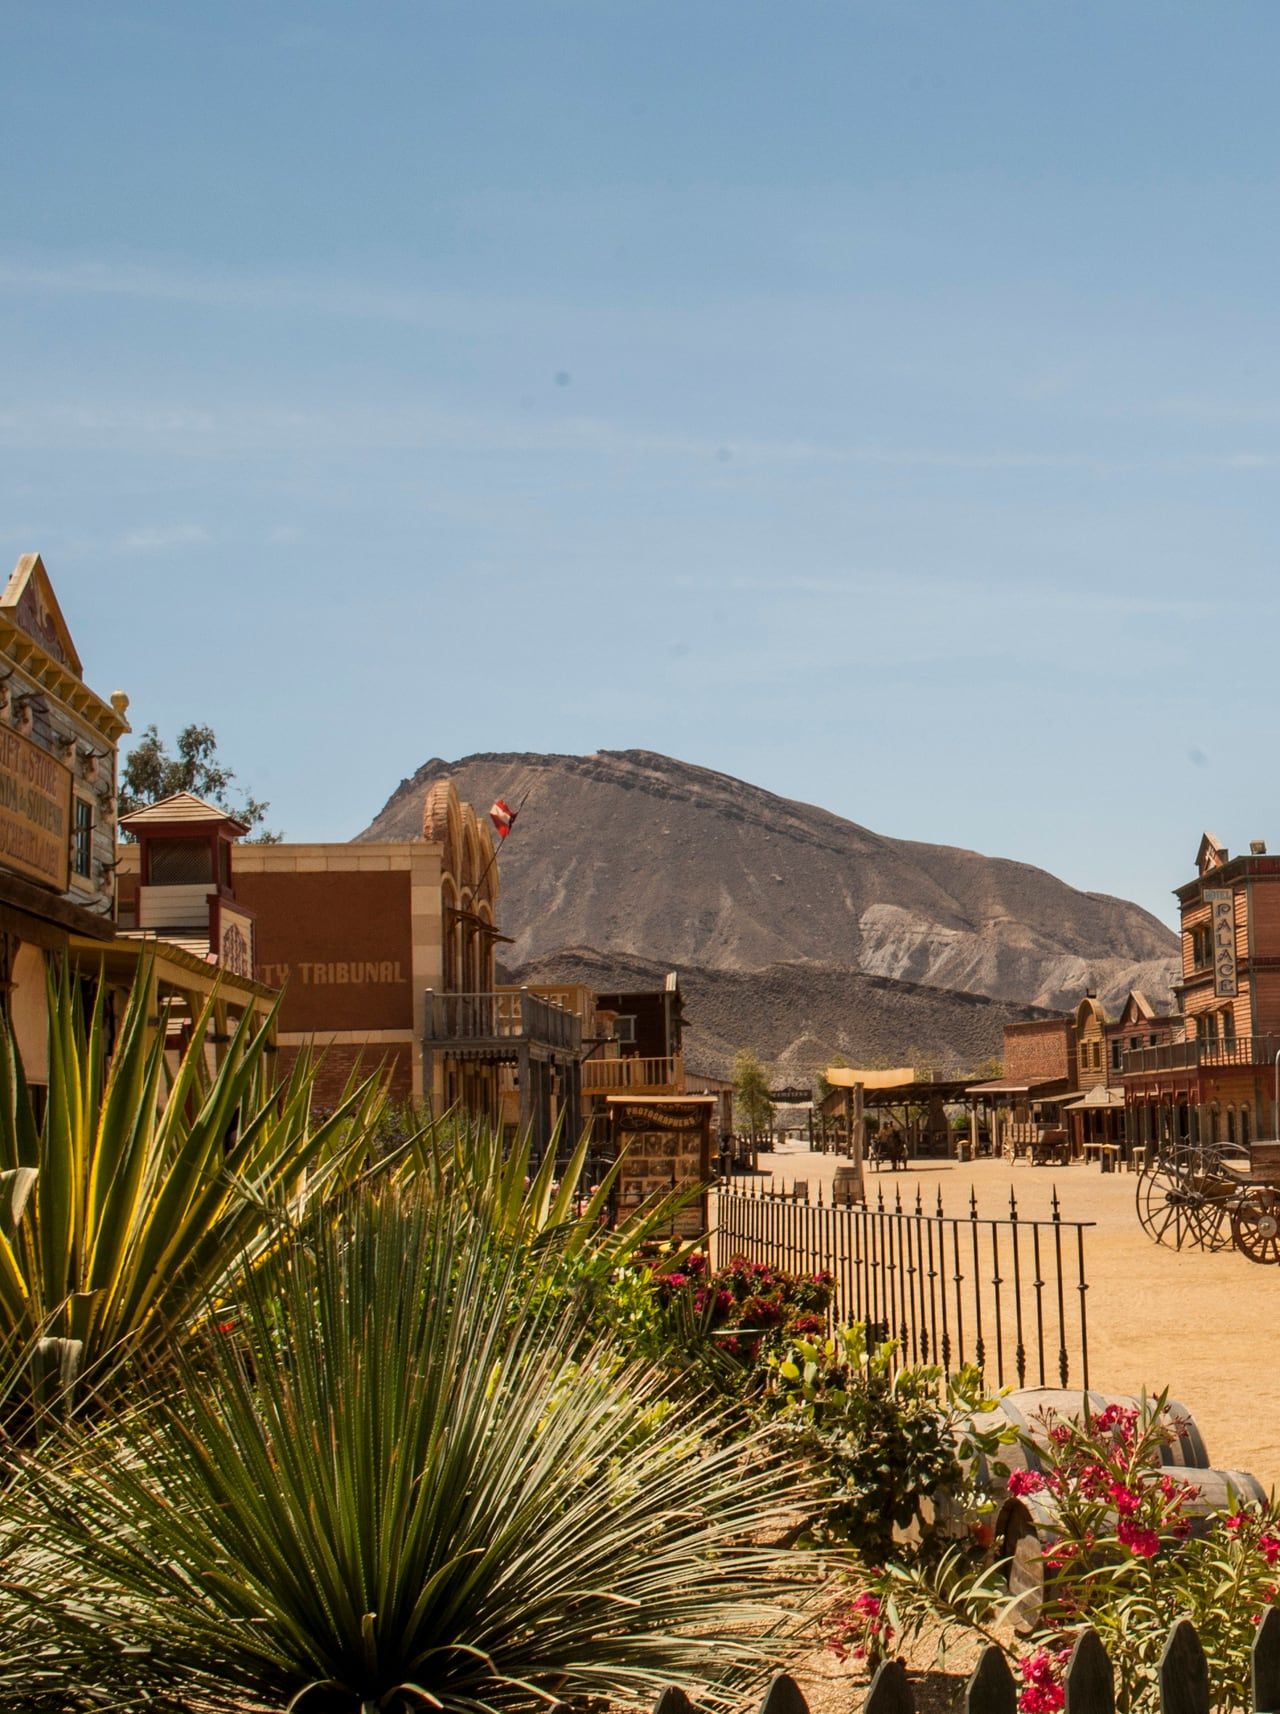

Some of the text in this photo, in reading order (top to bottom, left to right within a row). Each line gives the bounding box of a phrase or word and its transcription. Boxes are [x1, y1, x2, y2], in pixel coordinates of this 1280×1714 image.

[28, 751, 57, 797] STORE
[1205, 890, 1231, 901] HOTEL
[1216, 904, 1234, 993] PALACE
[299, 961, 406, 984] TRIBUNAL
